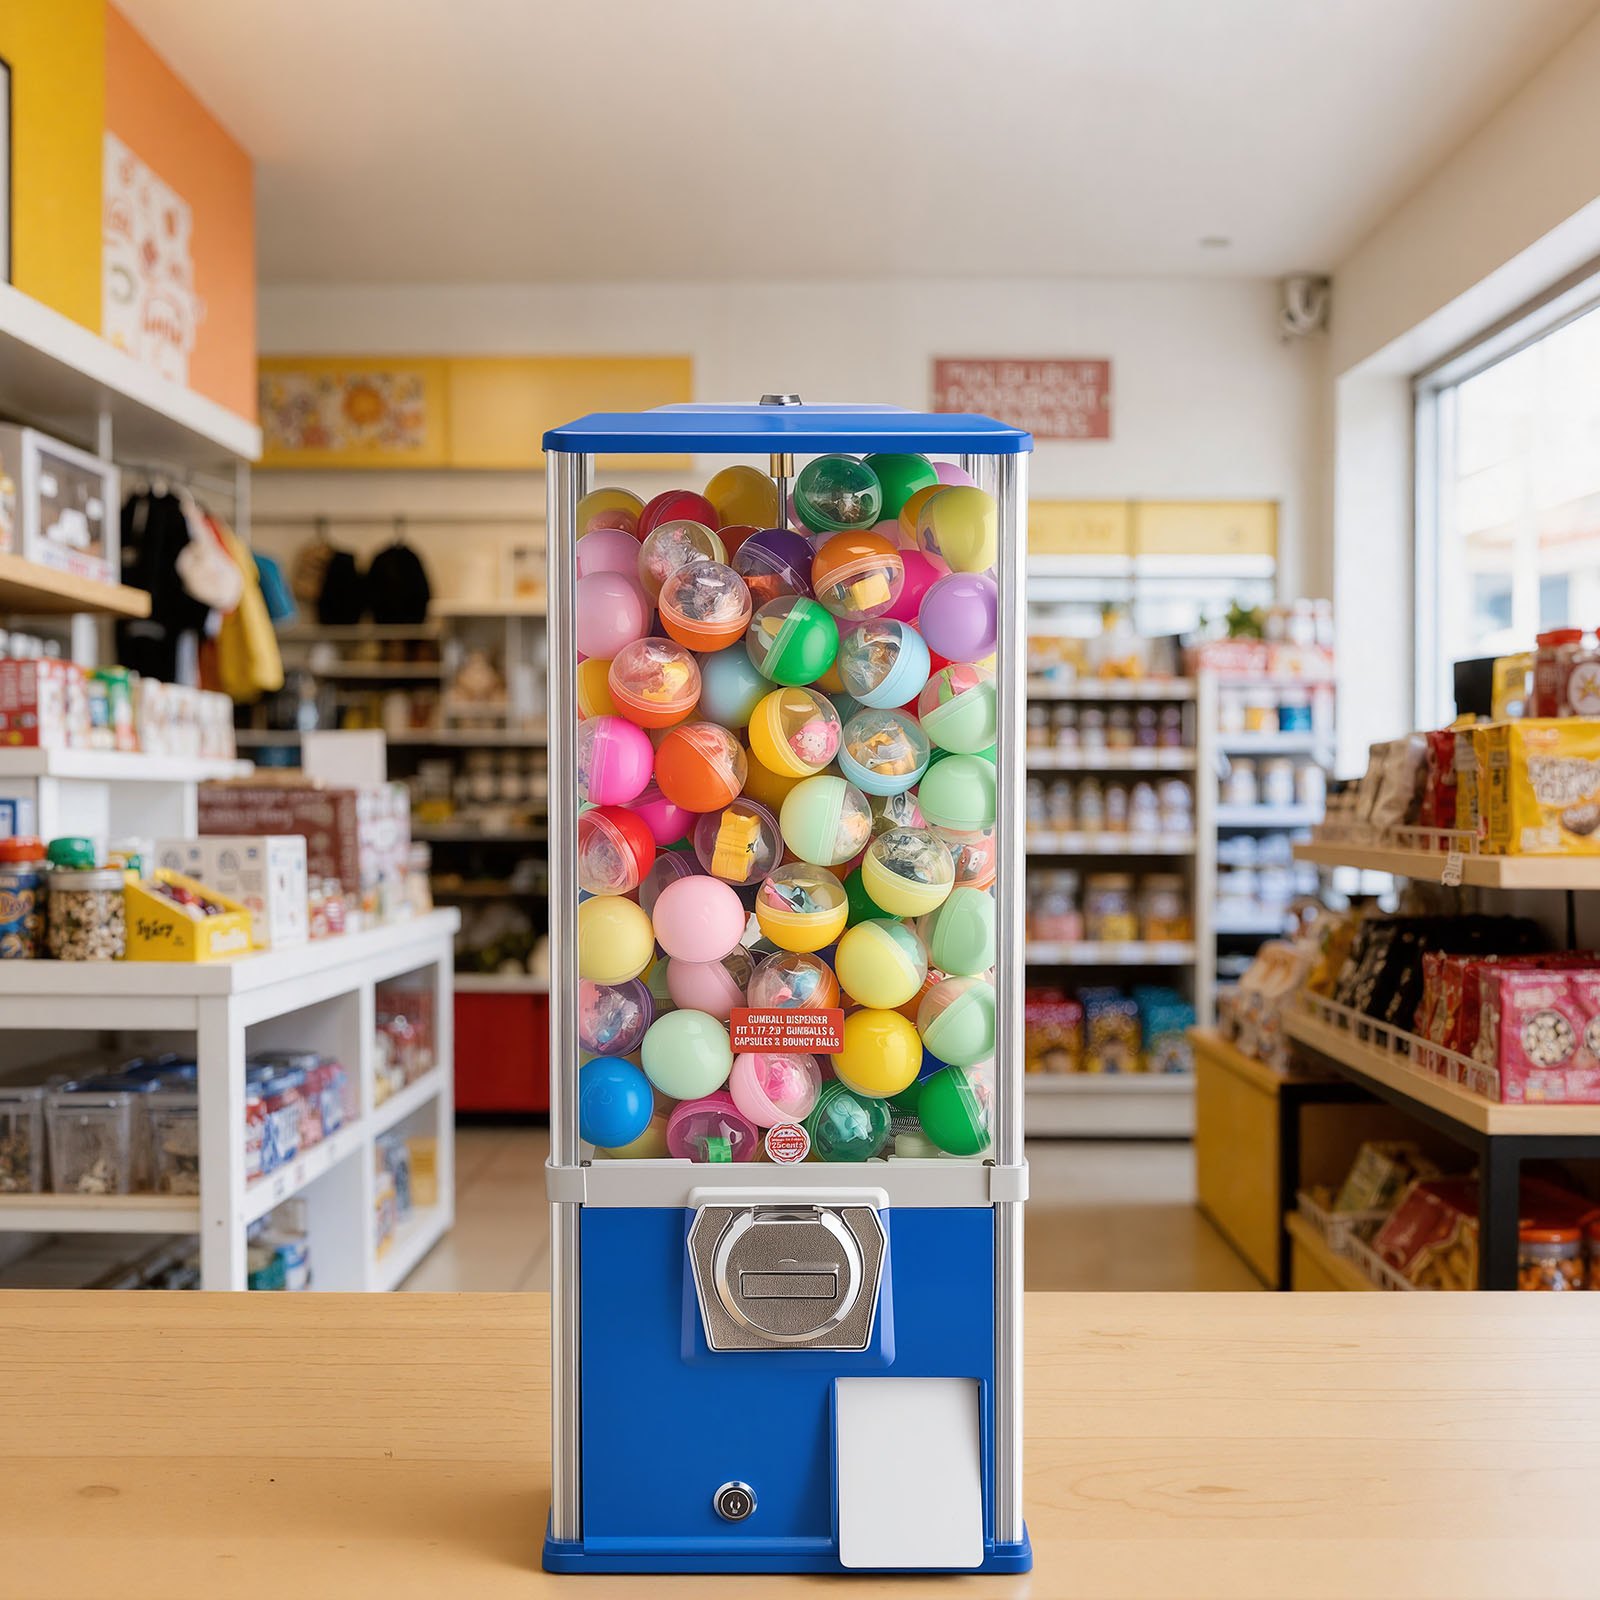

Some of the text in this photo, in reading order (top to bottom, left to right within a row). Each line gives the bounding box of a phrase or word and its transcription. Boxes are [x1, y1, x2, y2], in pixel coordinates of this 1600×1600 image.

[748, 1015, 827, 1024] GUMBALL DISPENSER
[736, 1026, 747, 1034] FIT
[786, 1026, 827, 1035] GUMBALLS
[829, 1027, 835, 1035] &
[734, 1037, 840, 1046] CAPSULES & BOUNCY BALLS
[771, 1141, 803, 1149] 25cents
